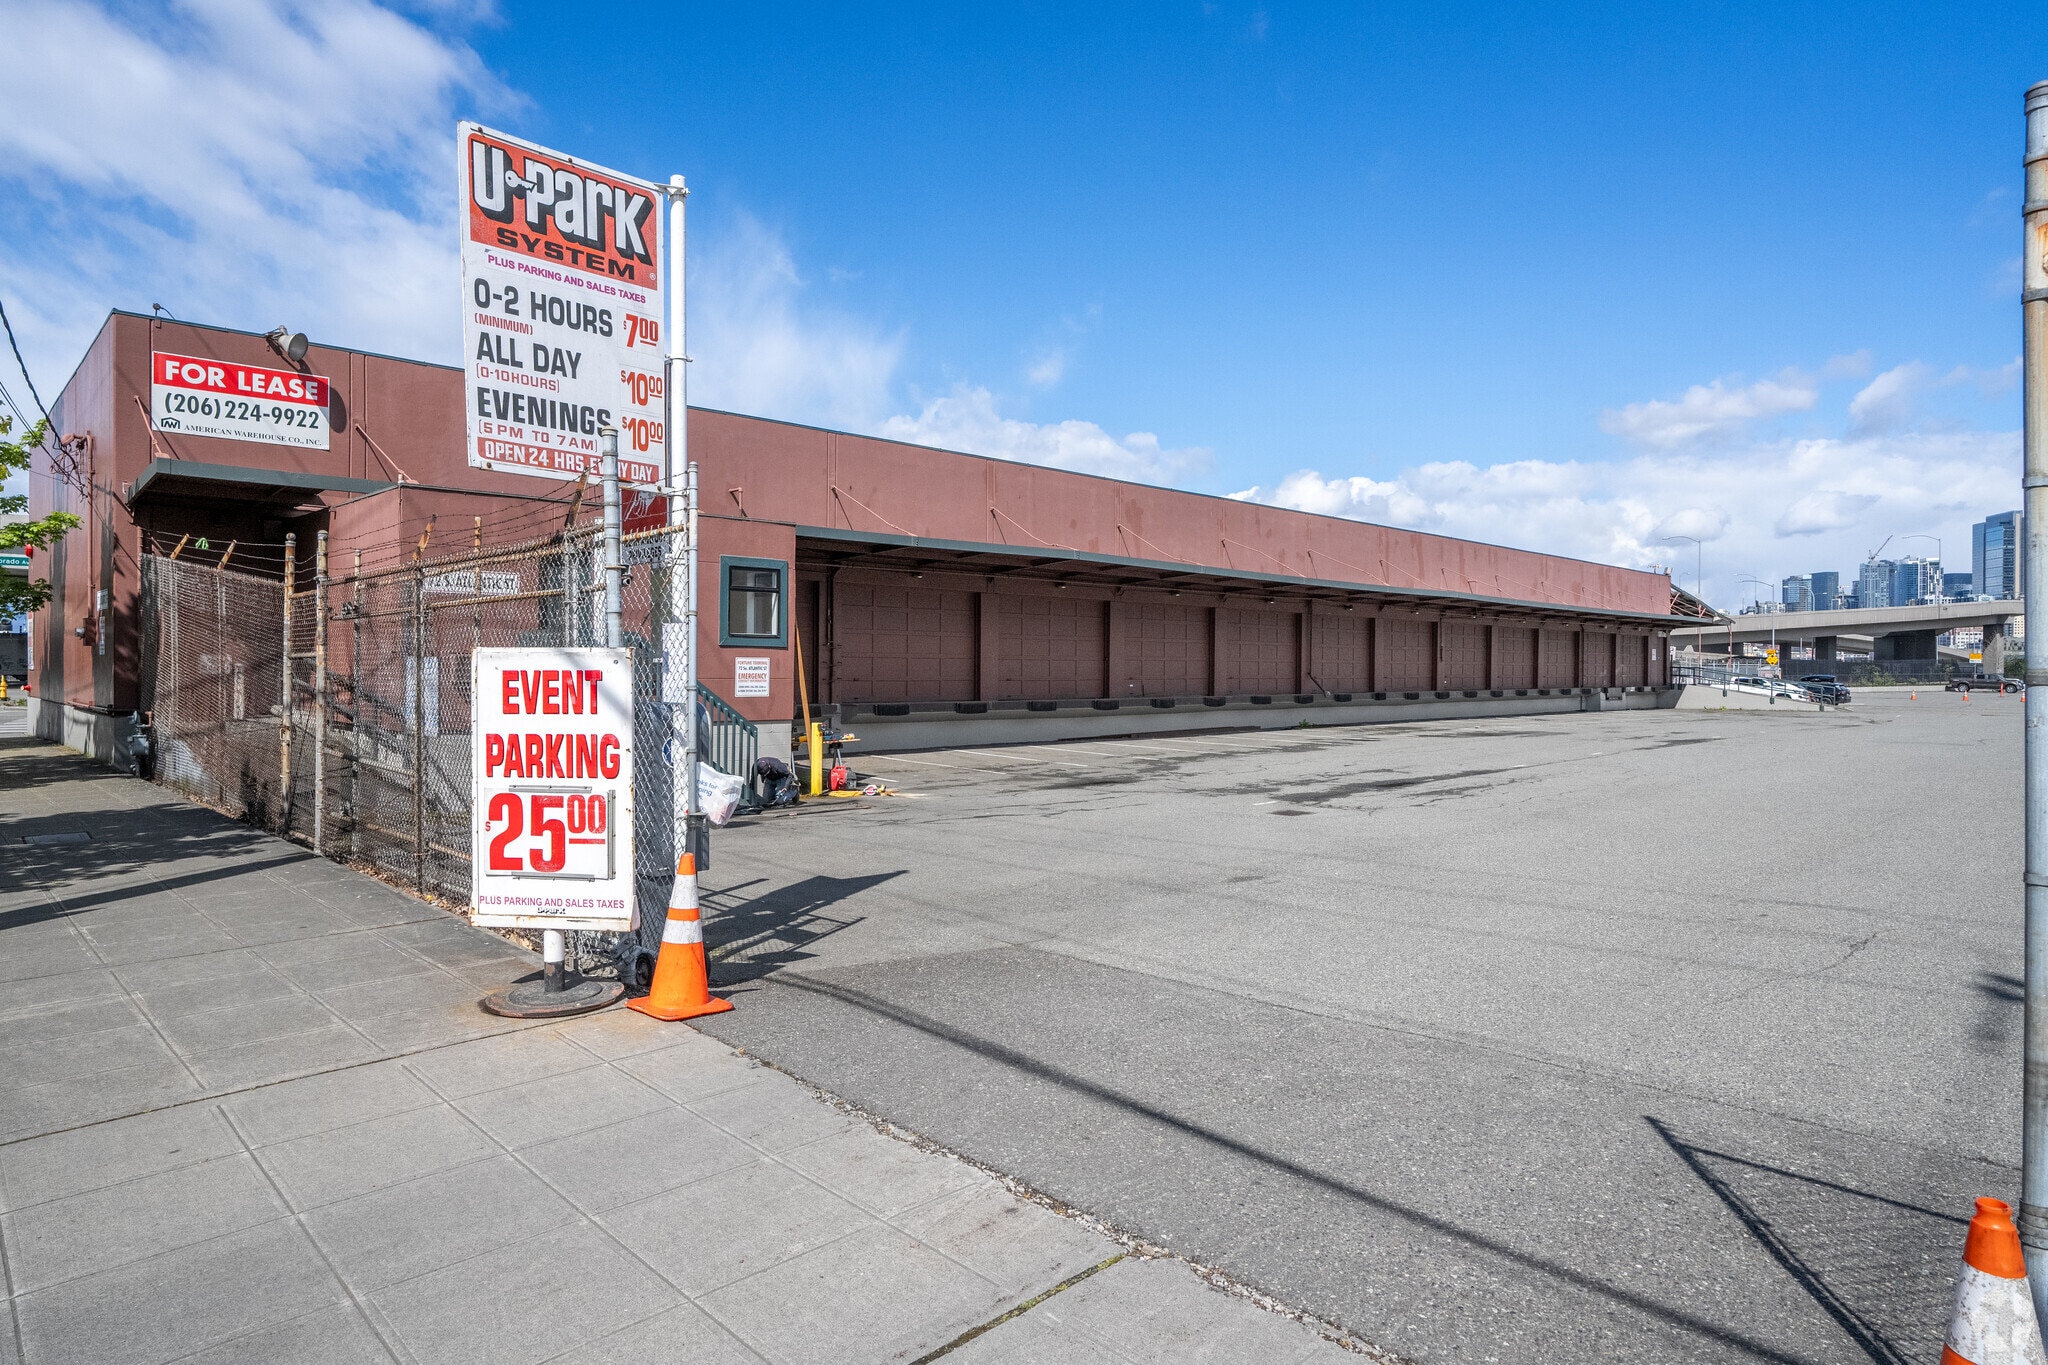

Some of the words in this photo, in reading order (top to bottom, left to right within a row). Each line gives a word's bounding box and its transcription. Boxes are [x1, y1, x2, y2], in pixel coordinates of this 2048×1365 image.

[497, 227, 635, 280] SYSTEM
[488, 255, 515, 270] PLUS
[518, 262, 561, 281] PARKING
[564, 275, 584, 287] AND
[586, 281, 616, 296] SALES
[618, 289, 646, 304] TAXES
[474, 278, 519, 316] 0-2
[530, 291, 613, 337] HOURS
[475, 313, 533, 335] (MINIMUM)
[476, 332, 523, 368] ALL
[533, 343, 582, 379] DAY
[165, 360, 226, 388] FOR
[238, 371, 318, 400] LEASE
[184, 425, 232, 435] AMERICAN
[234, 430, 286, 442] WAREHOUSE
[477, 386, 611, 437] EVENINGS
[498, 424, 523, 439] PM
[532, 430, 549, 443] TO
[484, 440, 525, 463] OPEN
[529, 449, 549, 466] 24
[554, 452, 584, 472] HRS
[590, 457, 628, 478] EVY
[631, 463, 652, 482] DAY
[502, 670, 603, 715] EVENT
[486, 733, 621, 780] PARKING
[479, 896, 502, 905] PLUS
[504, 896, 542, 906] PARKING
[544, 897, 563, 907] AND
[565, 899, 594, 908] SALES
[596, 899, 625, 909] TAXES
